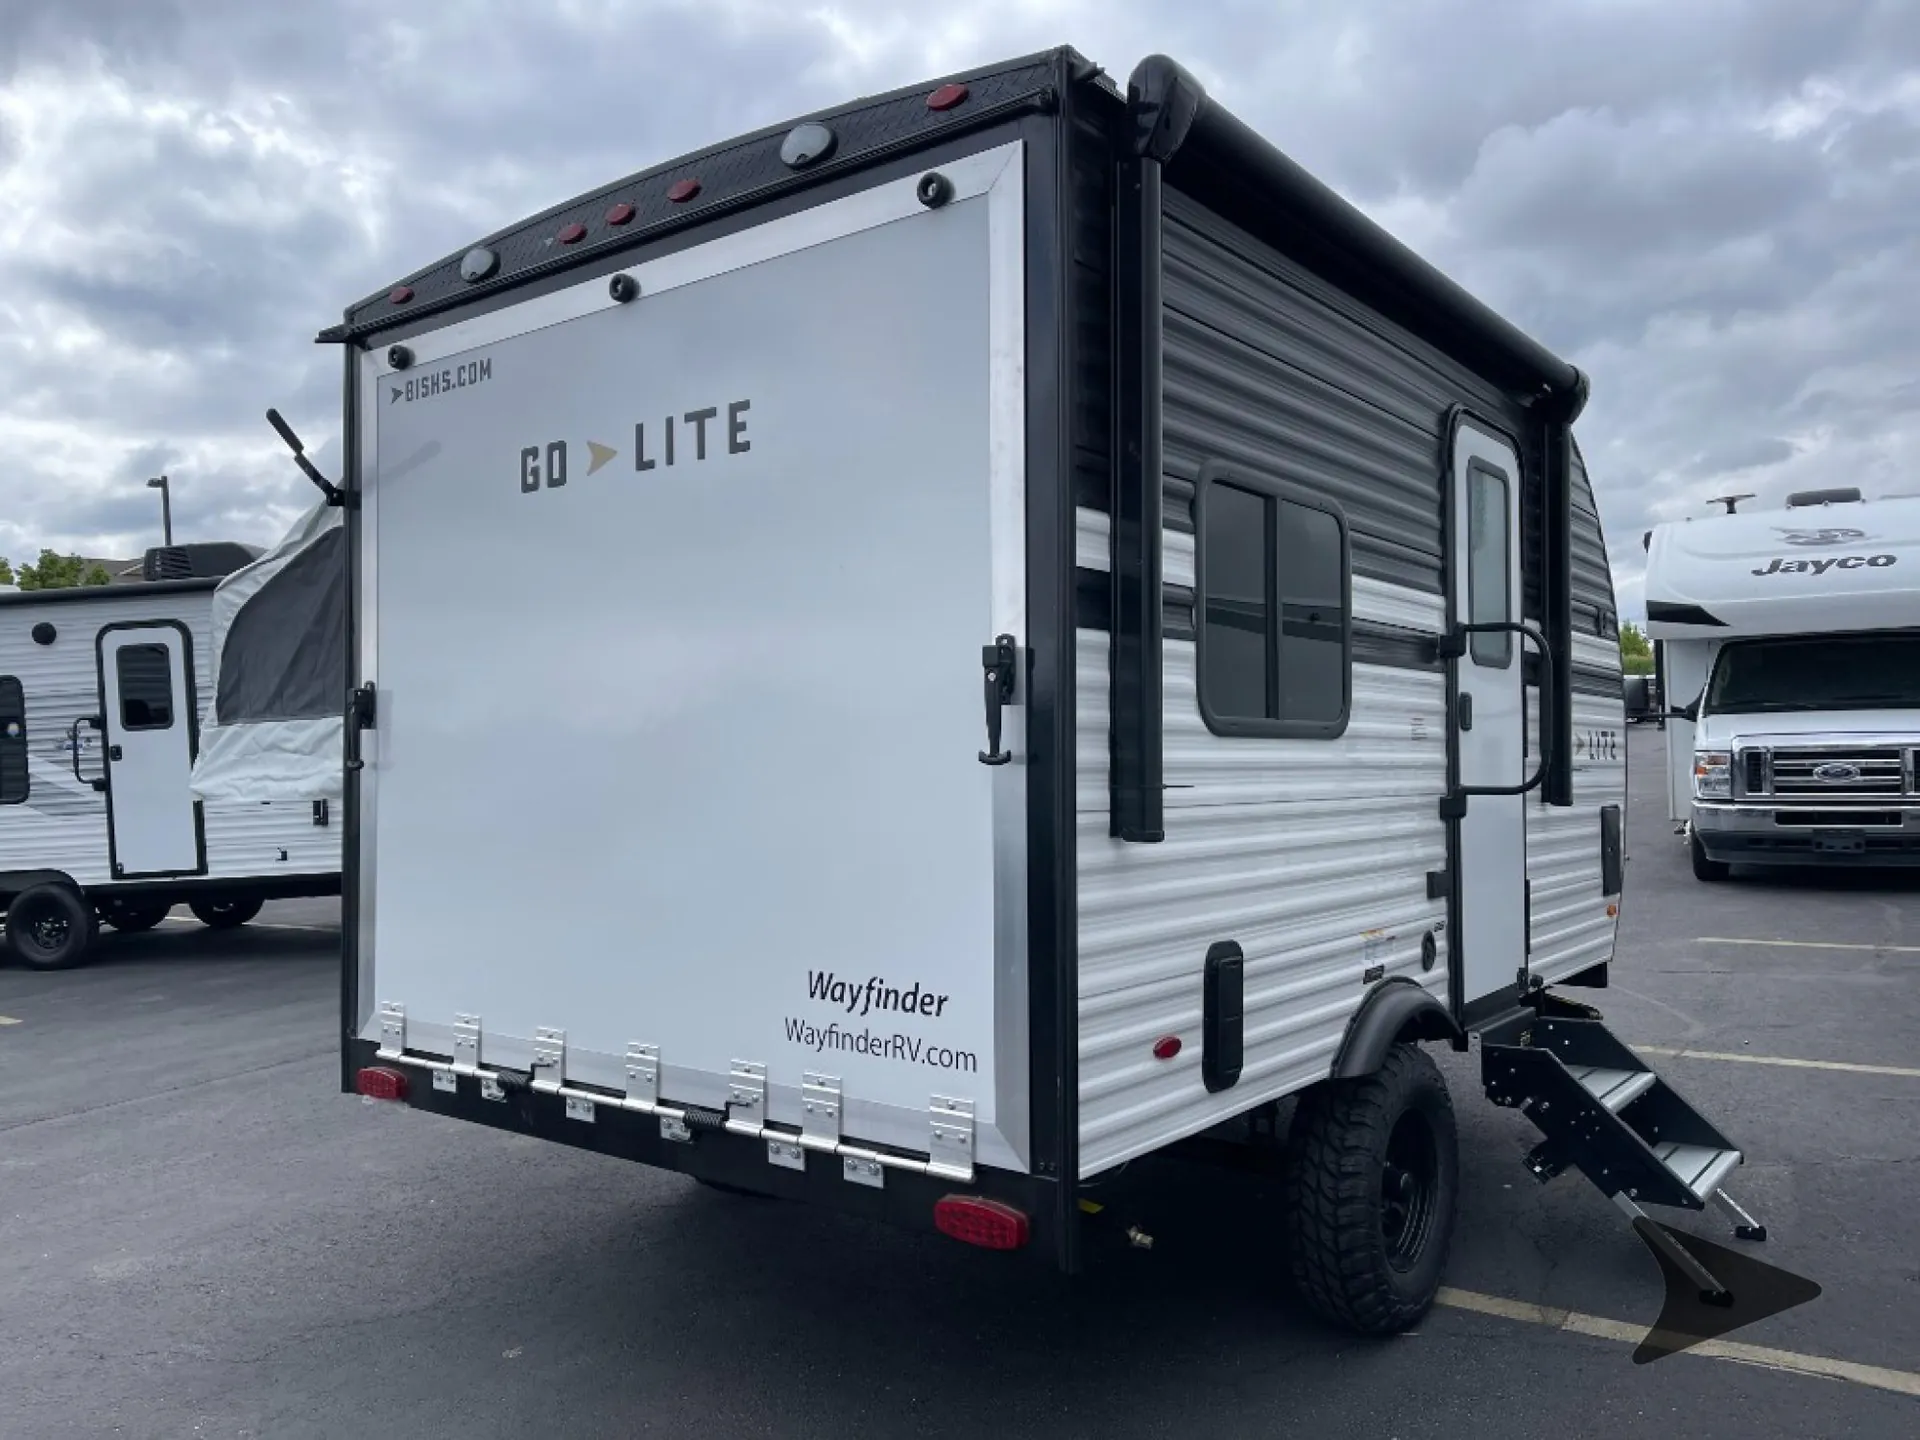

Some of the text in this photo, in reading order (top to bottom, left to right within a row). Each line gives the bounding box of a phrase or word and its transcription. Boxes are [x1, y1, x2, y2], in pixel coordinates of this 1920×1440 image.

[405, 358, 491, 401] BISHS.COM
[520, 399, 751, 493] GO LITE
[1752, 554, 1897, 576] Jayco
[1588, 730, 1617, 760] LITE
[808, 970, 948, 1016] Wayfinder
[785, 1017, 977, 1072] WayfinderRV.com
